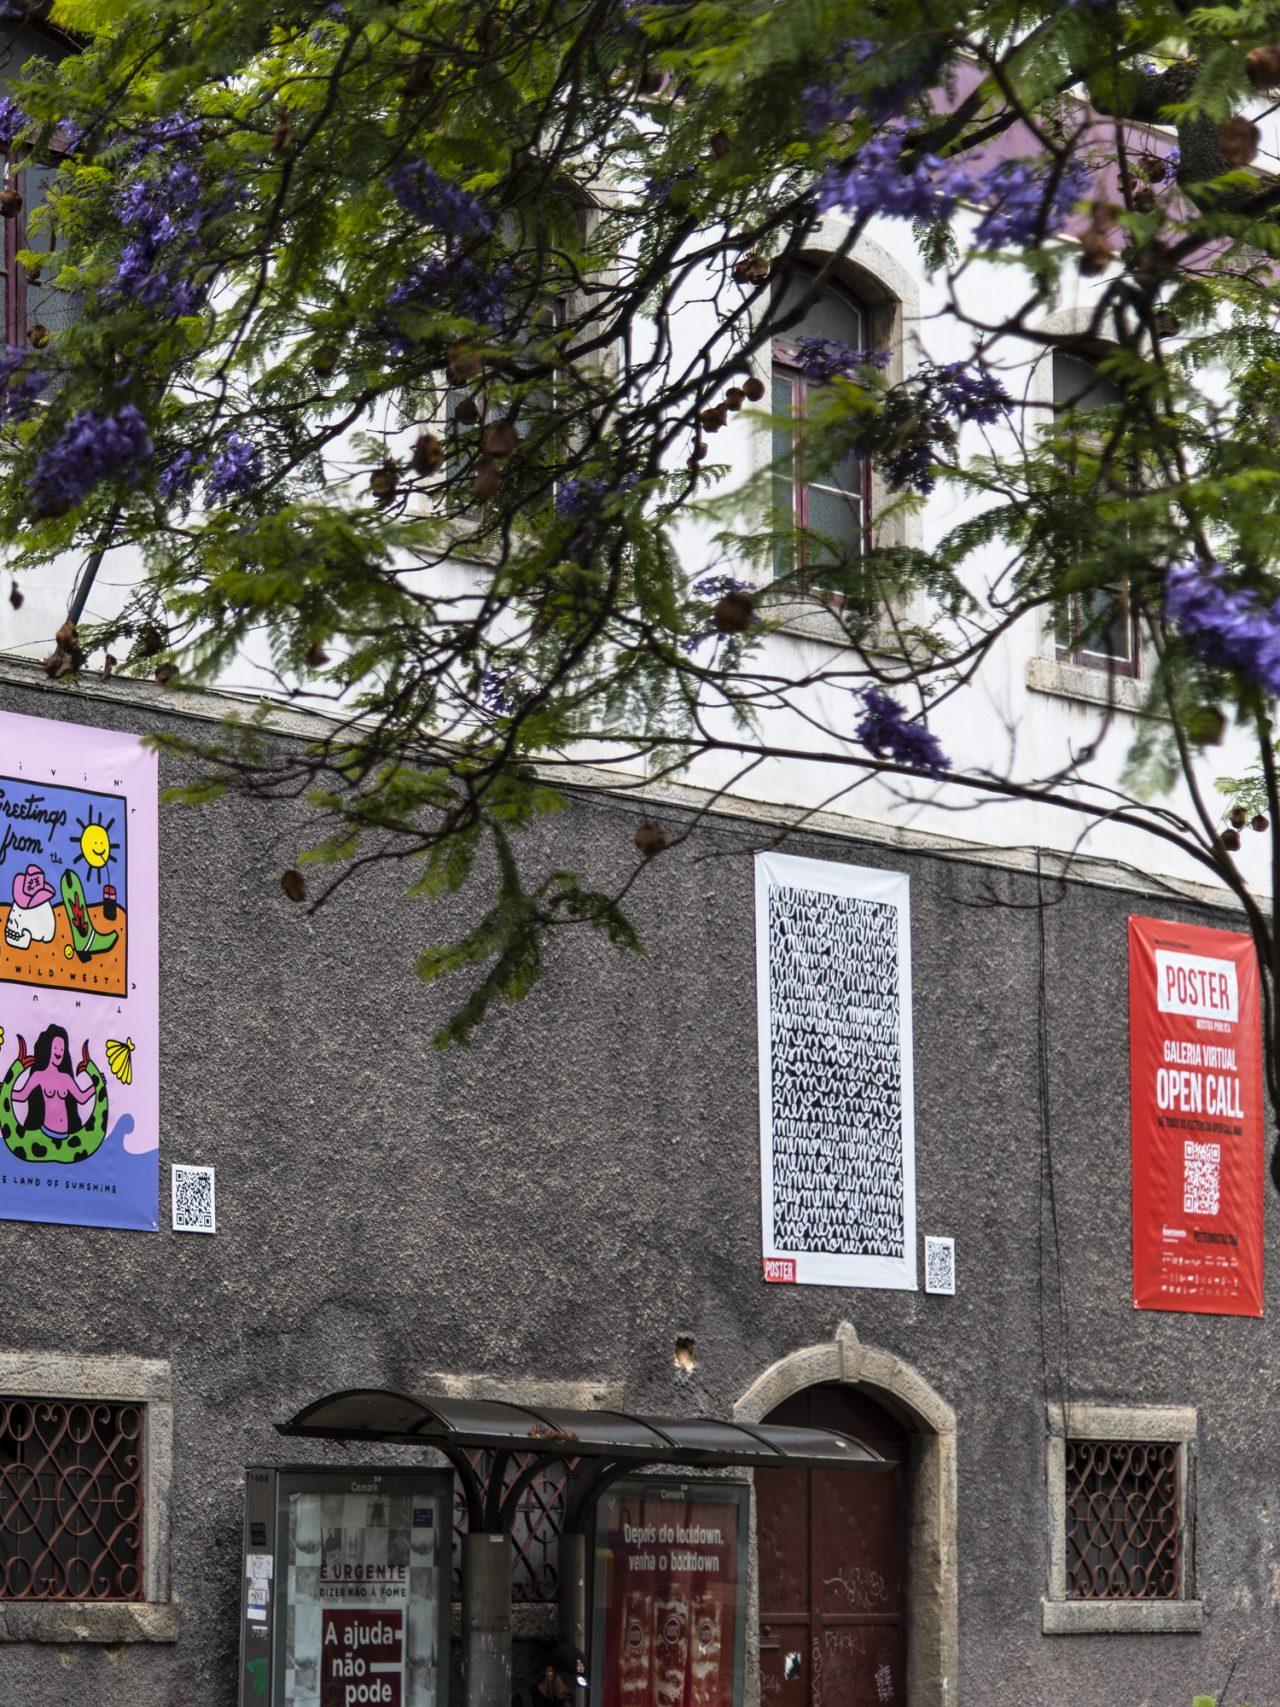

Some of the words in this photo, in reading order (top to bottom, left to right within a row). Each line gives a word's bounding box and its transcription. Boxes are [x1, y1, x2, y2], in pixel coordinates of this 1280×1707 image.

[50, 851, 63, 864] the
[1166, 965, 1229, 1011] POSTER
[1164, 1040, 1202, 1066] GALERIA
[1203, 1045, 1238, 1071] VIRTUAL
[1157, 1068, 1202, 1114] OPEN
[1206, 1074, 1244, 1119] CALL
[13, 1176, 40, 1186] LAND
[47, 1179, 60, 1188] OF
[766, 1261, 793, 1280] POSTER
[351, 1482, 379, 1492] Cemark
[661, 1489, 685, 1499] Cemark
[624, 1523, 656, 1549] Depois
[659, 1523, 674, 1543] do
[676, 1523, 724, 1547] lockdown,
[334, 1564, 406, 1580] URGENTE
[629, 1551, 656, 1571] venha
[659, 1555, 667, 1571] o
[671, 1551, 720, 1572] bockdown
[320, 1588, 345, 1597] DIZER
[347, 1586, 367, 1597] NÃO
[380, 1588, 407, 1598] FOME
[325, 1622, 338, 1645] A
[344, 1621, 393, 1649] ajuda
[332, 1652, 366, 1677] não
[345, 1679, 392, 1704] pode
